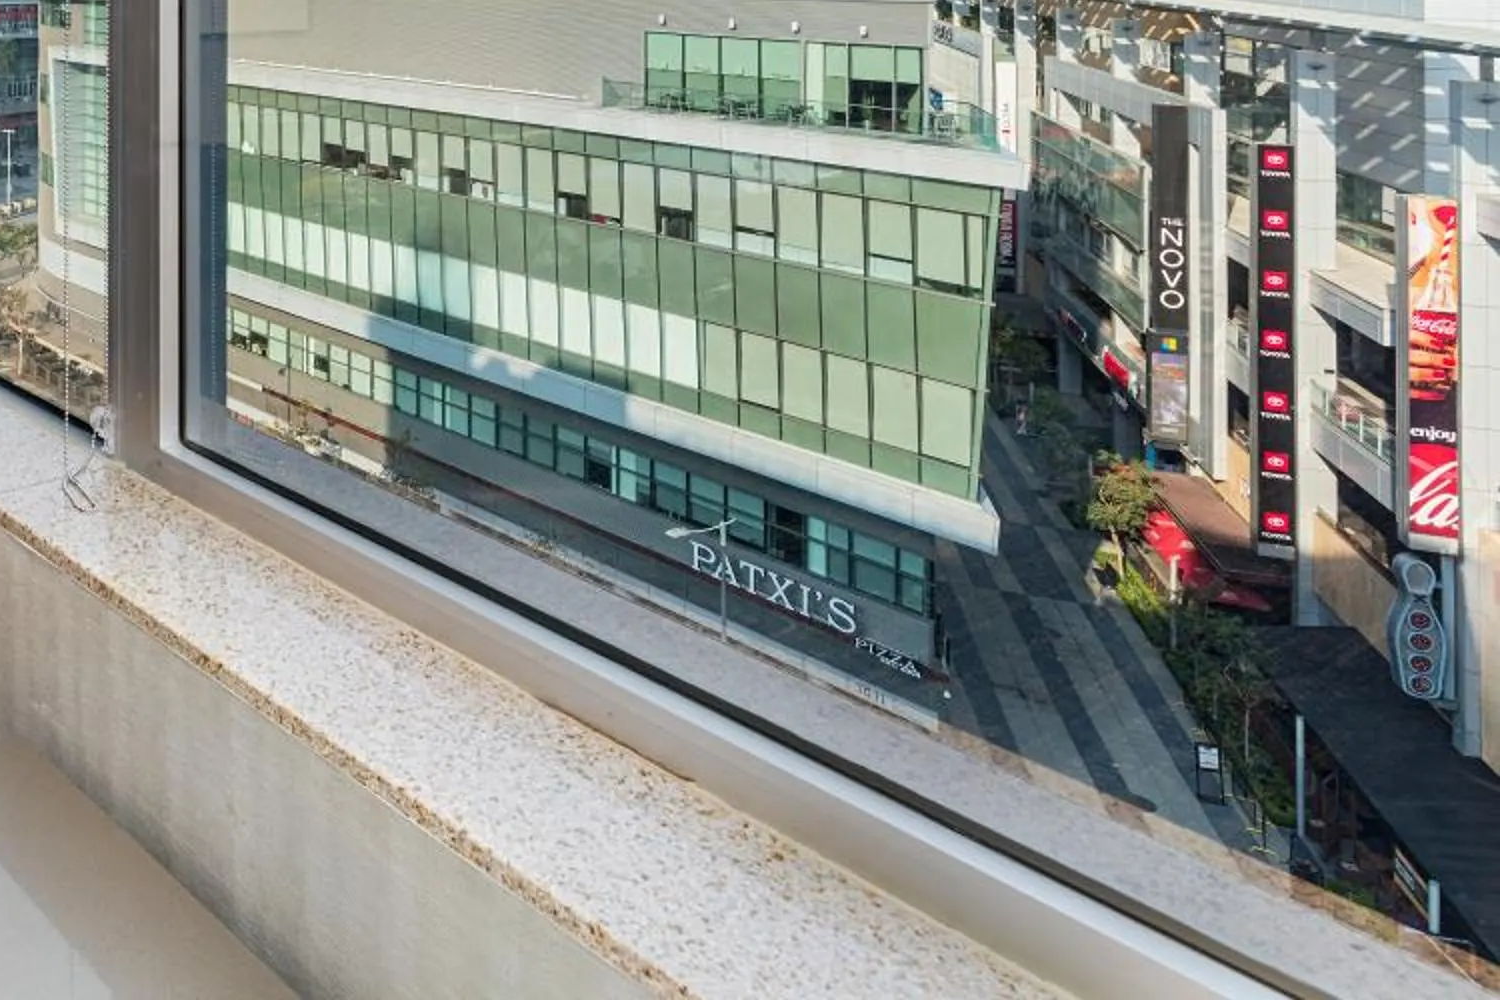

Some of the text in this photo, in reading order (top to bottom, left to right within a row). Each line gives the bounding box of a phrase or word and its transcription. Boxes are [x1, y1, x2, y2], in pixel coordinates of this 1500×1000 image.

[1159, 227, 1185, 309] NOVO
[1410, 426, 1457, 443] enjoy
[690, 540, 857, 634] PATXI'S
